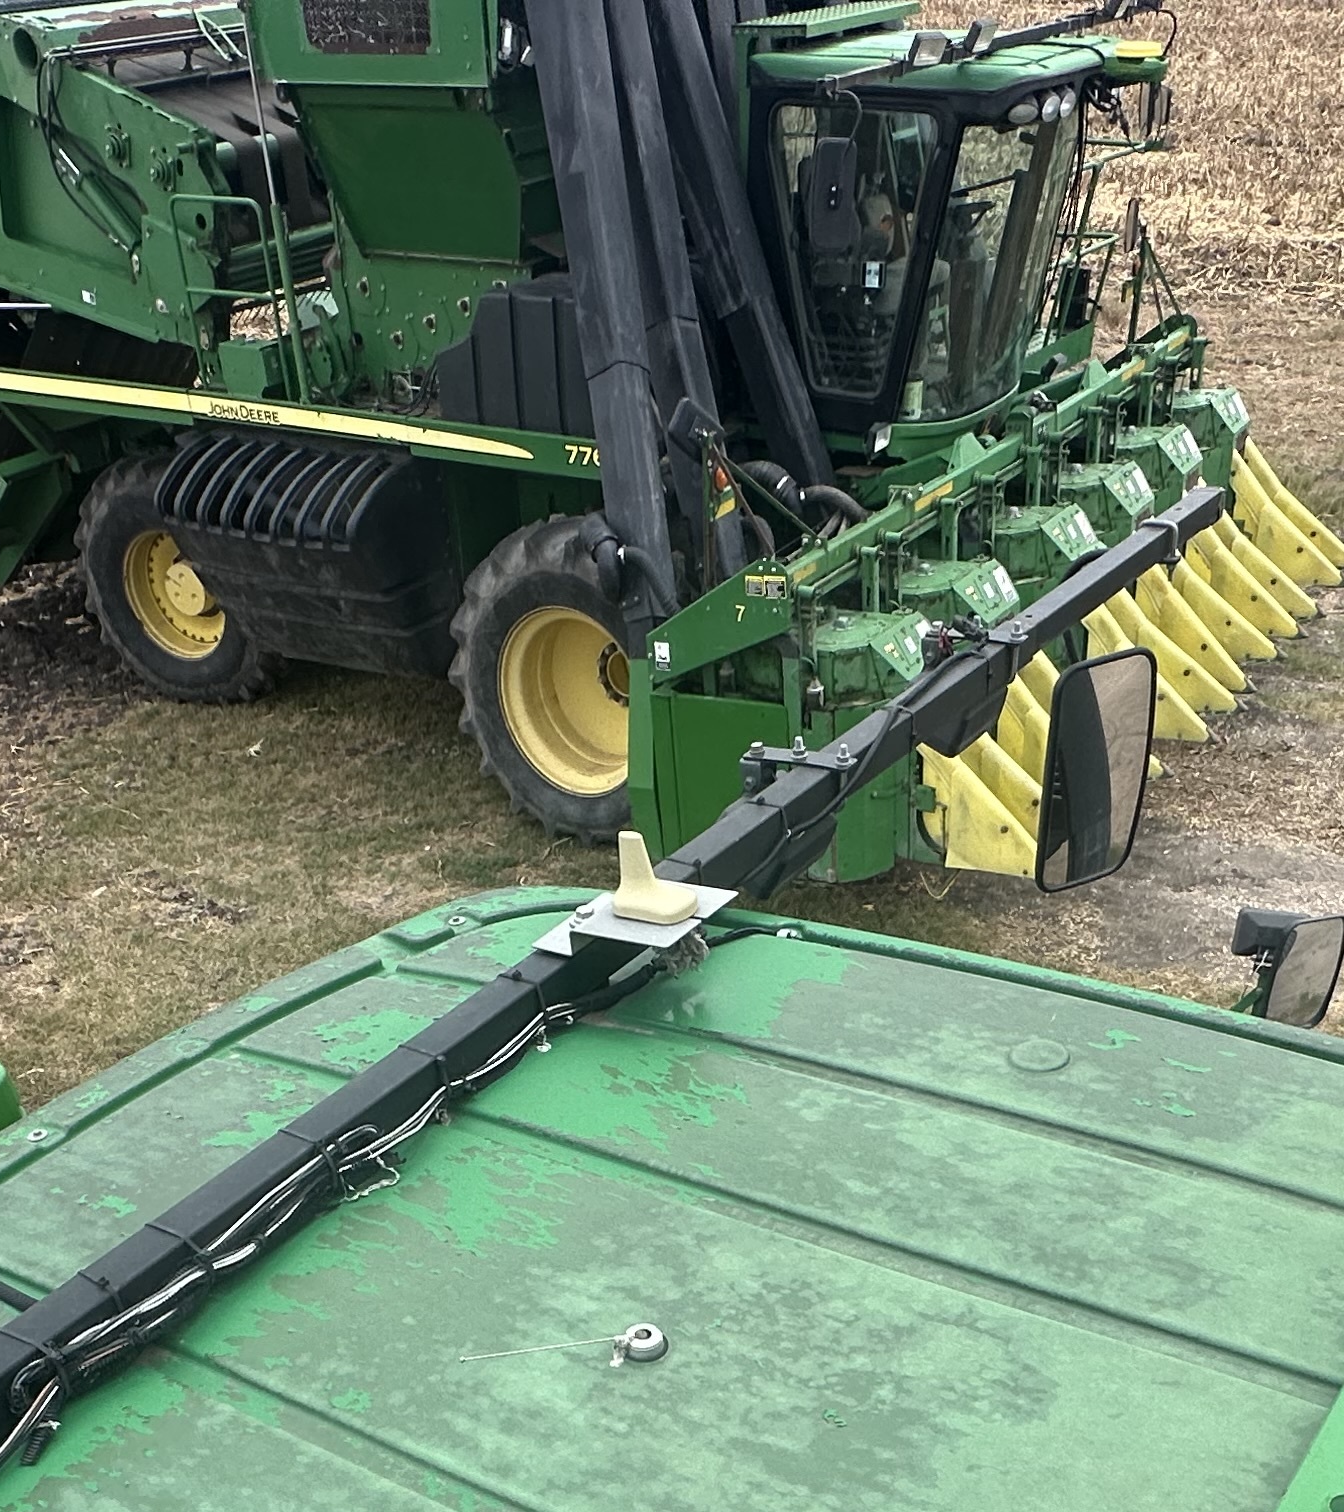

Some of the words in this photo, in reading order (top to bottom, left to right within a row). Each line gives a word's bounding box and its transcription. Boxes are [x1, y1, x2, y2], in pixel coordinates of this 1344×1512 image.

[208, 401, 239, 418] JOHN
[239, 404, 280, 423] DEERE
[735, 604, 746, 622] 7
